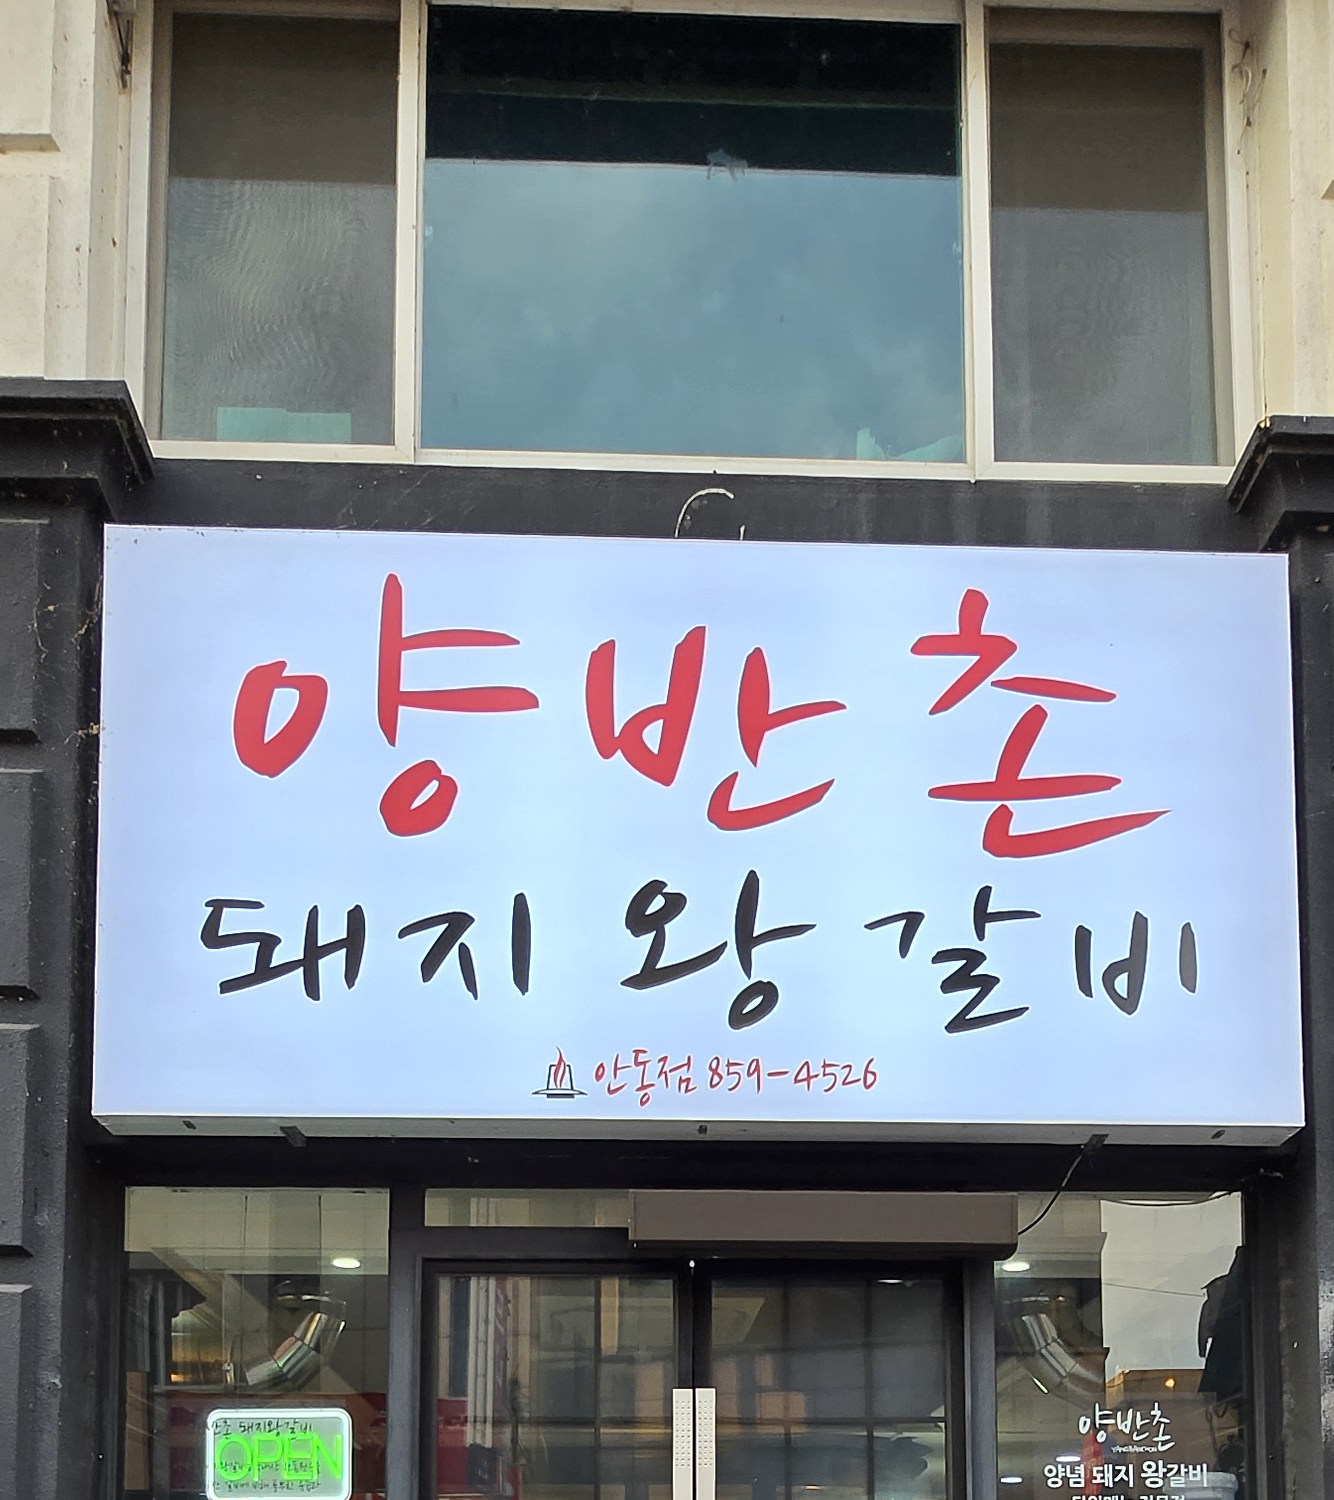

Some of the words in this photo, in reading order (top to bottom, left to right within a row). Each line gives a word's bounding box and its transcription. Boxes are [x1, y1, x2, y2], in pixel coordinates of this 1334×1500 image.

[232, 571, 1172, 858] 양반촌
[594, 1049, 697, 1107] 안동점
[708, 1056, 879, 1094] 859-4526
[1079, 1402, 1176, 1452] 양반촌
[215, 1433, 343, 1481] OPEN
[1044, 1463, 1085, 1488] 양념
[1091, 1463, 1134, 1488] 돼지
[1140, 1460, 1208, 1488] 왕갈비
